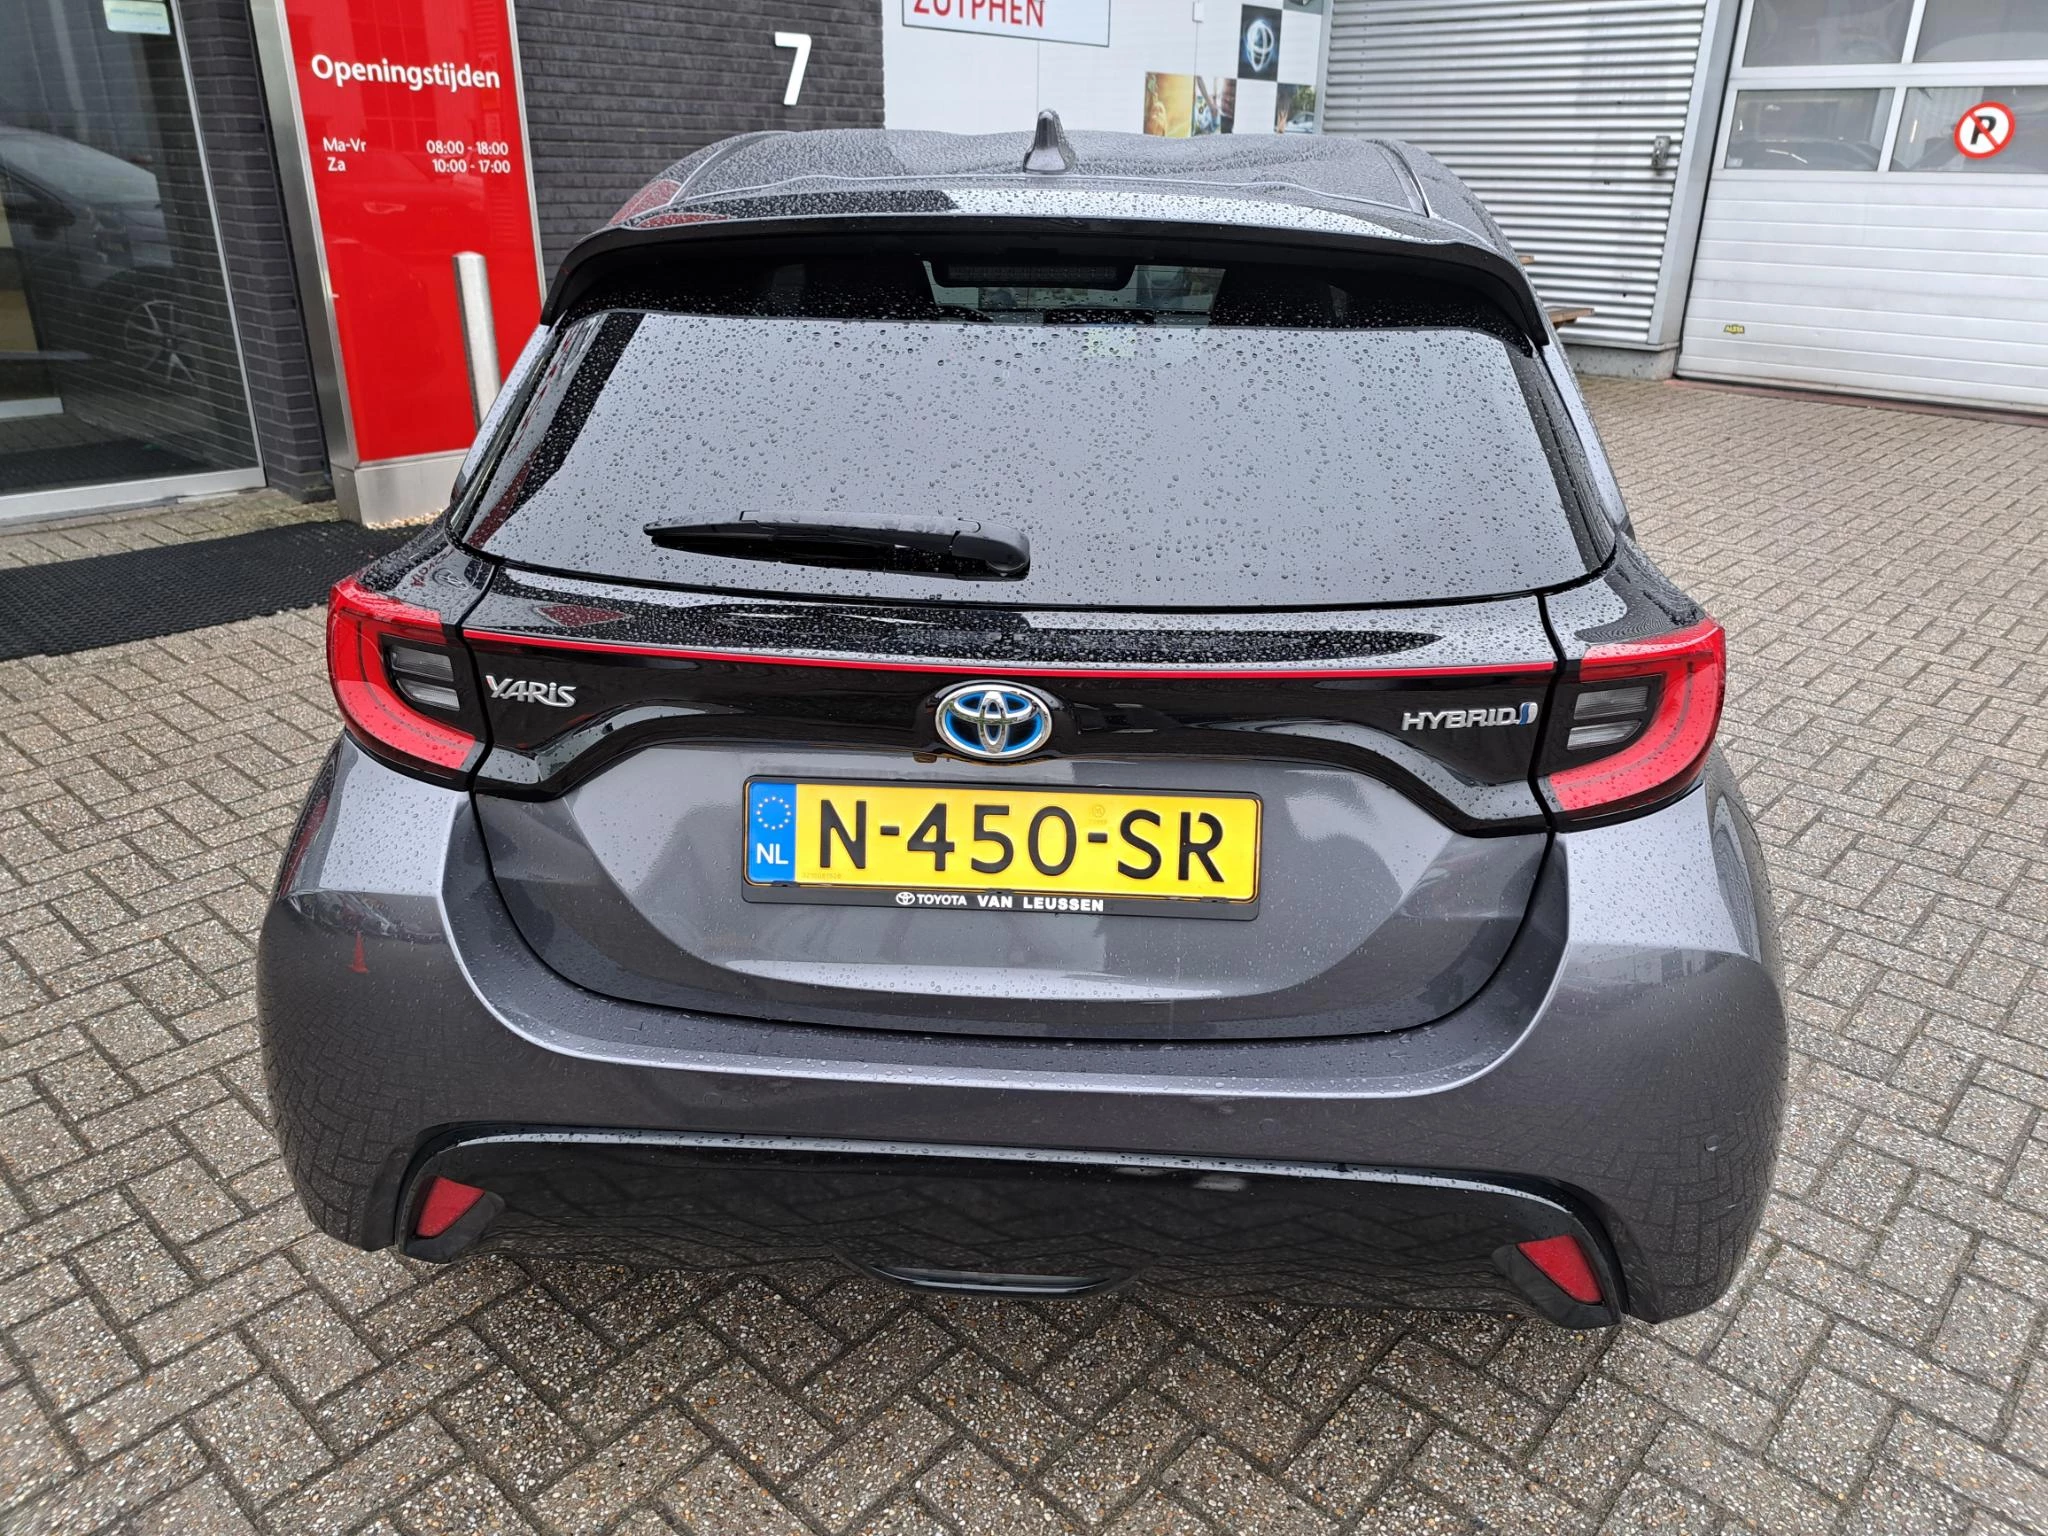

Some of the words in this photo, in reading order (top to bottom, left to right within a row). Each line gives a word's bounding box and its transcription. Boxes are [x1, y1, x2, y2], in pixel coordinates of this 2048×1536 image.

[311, 54, 501, 93] Openingstijden
[775, 31, 812, 106] 7
[1970, 115, 1997, 145] P
[322, 137, 367, 152] Ma-Vr
[426, 140, 464, 154] 08:00
[476, 141, 509, 155] 18:00
[327, 157, 346, 172] Za
[432, 159, 467, 173] 10:00
[478, 160, 511, 174] 17:00
[1401, 707, 1517, 731] HYBRID
[819, 799, 1226, 883] N-450-SR
[756, 843, 788, 865] NL
[916, 894, 968, 906] TOYOTA
[977, 895, 1013, 909] VAN
[1023, 896, 1104, 912] LEUSSEN
